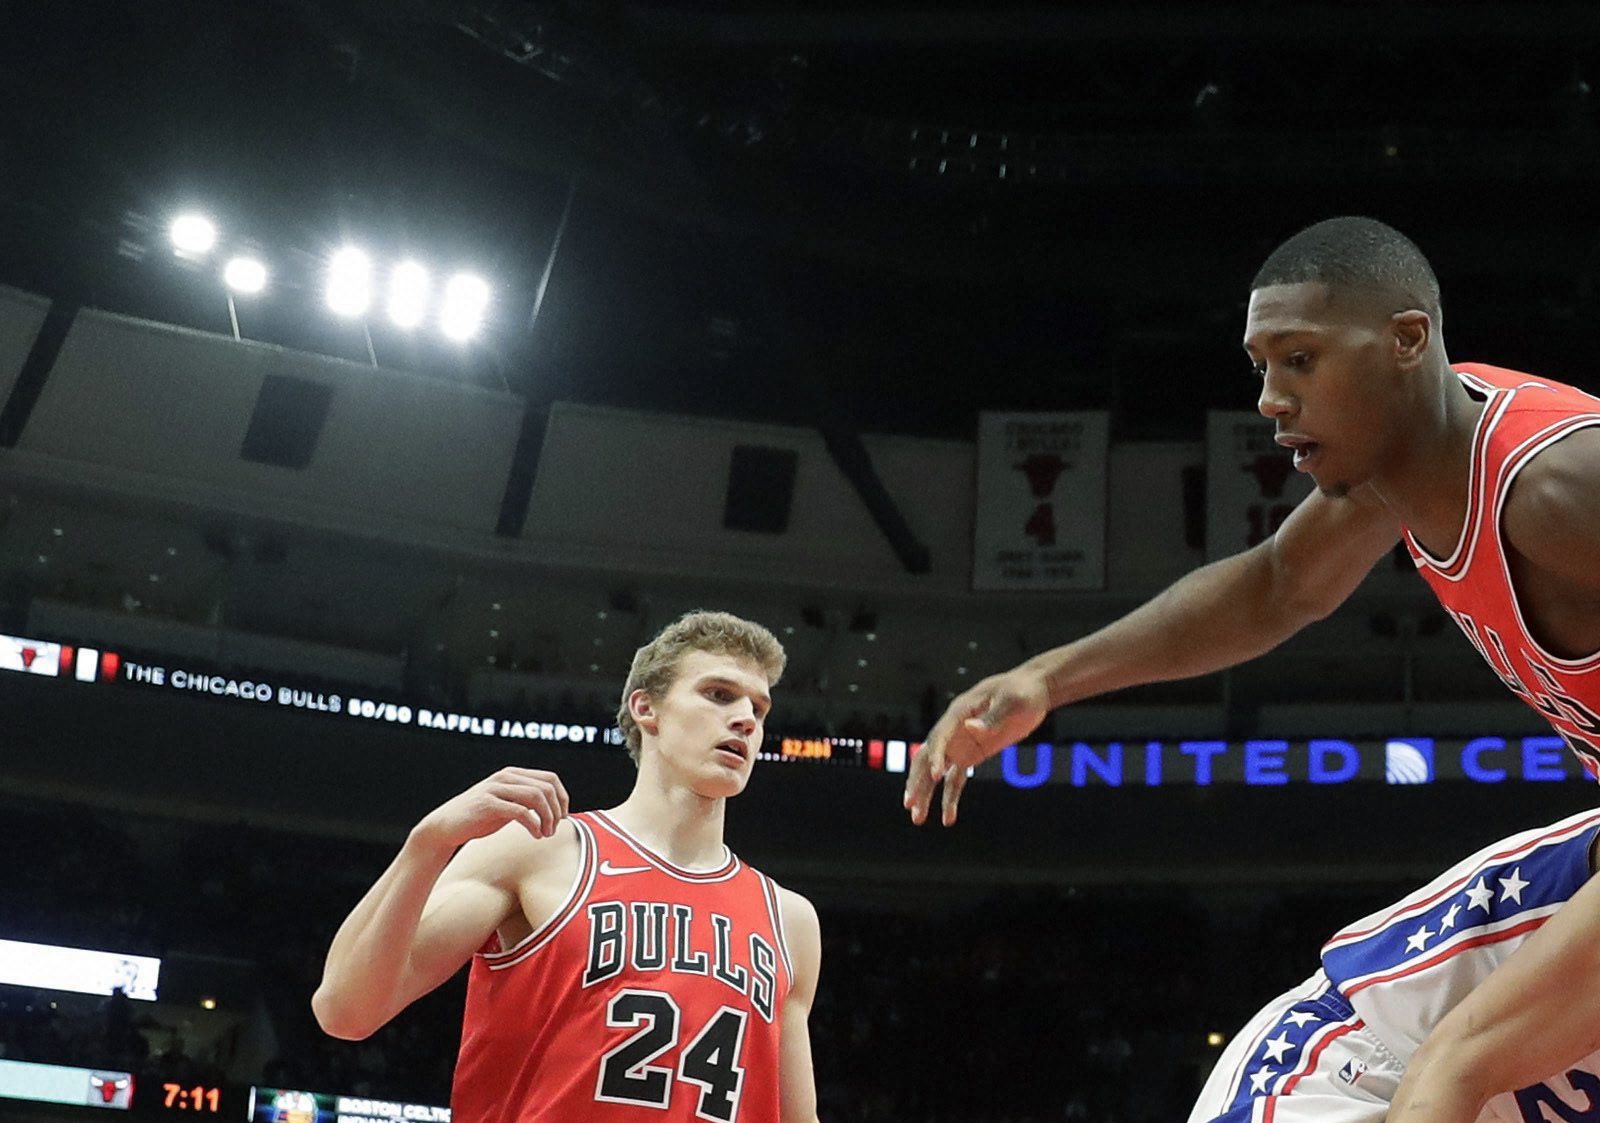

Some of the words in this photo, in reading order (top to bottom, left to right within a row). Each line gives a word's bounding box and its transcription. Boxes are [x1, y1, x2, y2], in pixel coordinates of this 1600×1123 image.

[125, 662, 165, 685] THE
[170, 670, 273, 701] CHICAGO
[278, 687, 342, 713] BULLS
[348, 698, 412, 724] 50/50
[418, 709, 496, 736] RAFFLE
[500, 719, 598, 744] JACKPOT
[1001, 741, 1361, 788] UNITED
[1461, 738, 1592, 785] CE
[582, 900, 777, 1024] BULLS
[163, 1082, 221, 1113] 7:11
[338, 1097, 395, 1117] BOSTON
[401, 1103, 452, 1122] CELTIC
